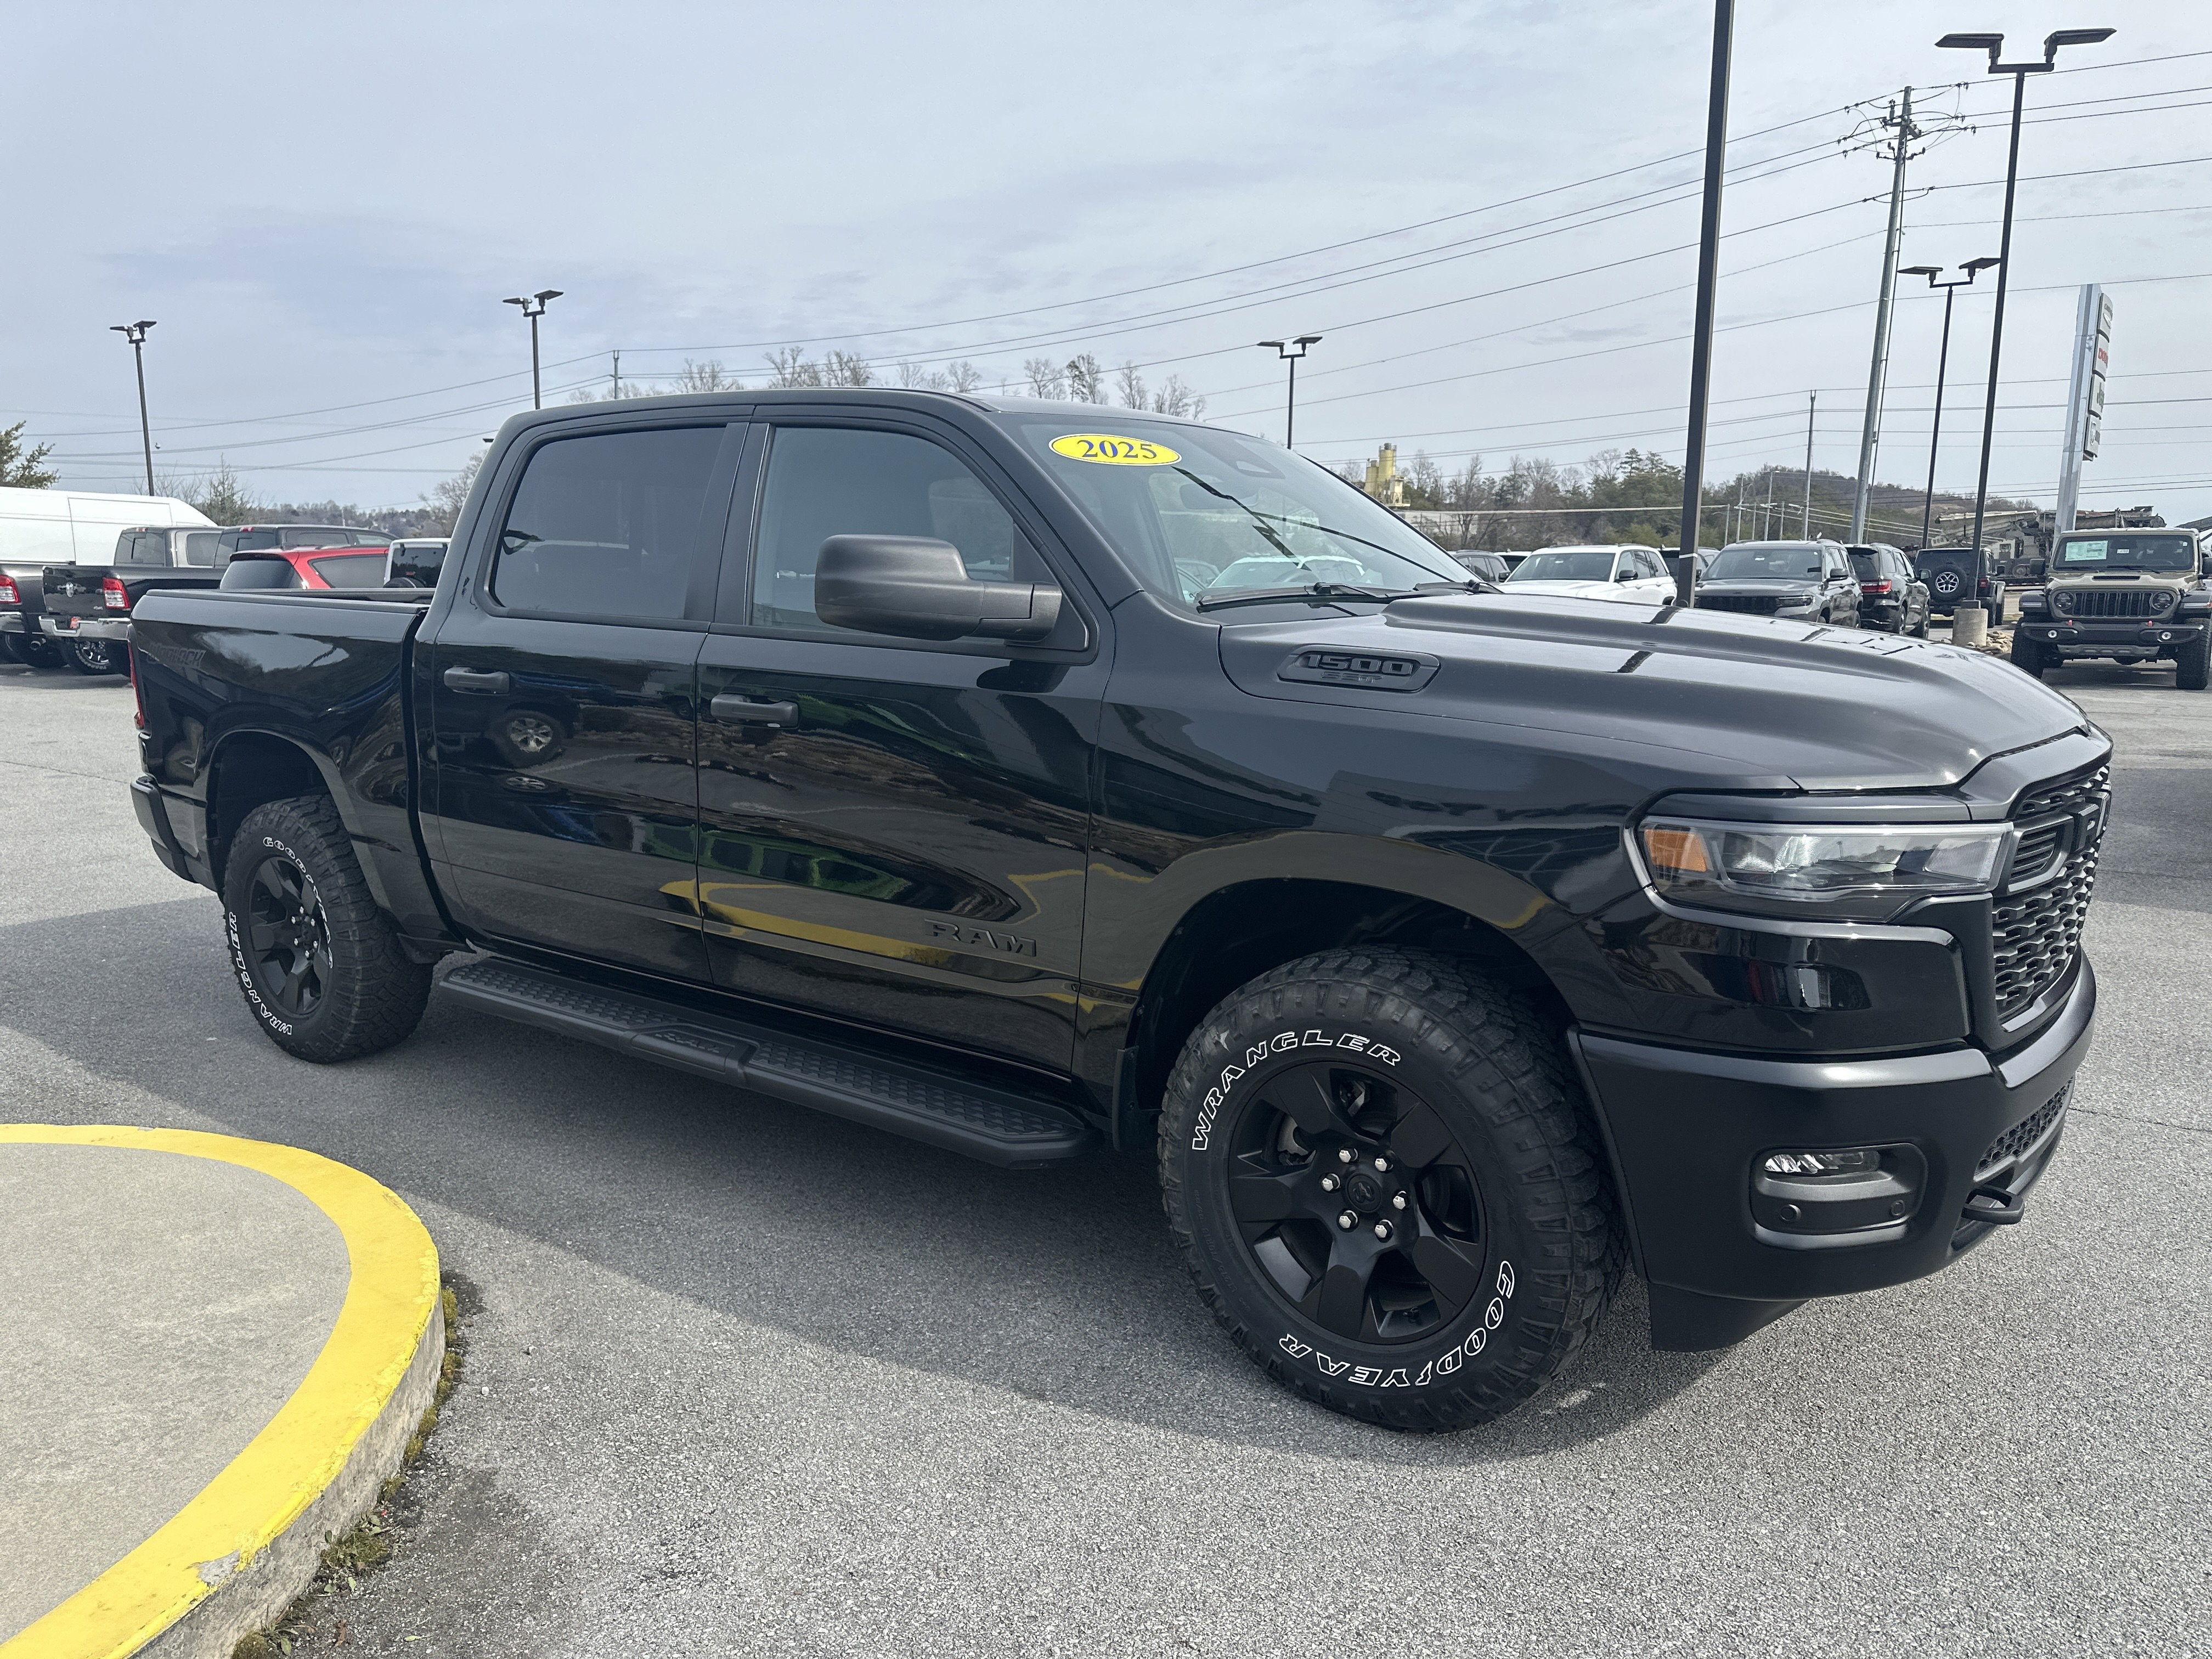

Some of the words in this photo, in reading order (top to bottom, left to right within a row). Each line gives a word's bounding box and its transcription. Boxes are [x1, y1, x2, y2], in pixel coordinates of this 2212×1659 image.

[1077, 439, 1158, 459] 2025
[1307, 653, 1413, 676] 1500
[229, 911, 292, 1036] WRANGLER
[924, 918, 1036, 957] RAM
[1192, 1029, 1401, 1152] WRANGLER
[1279, 1260, 1515, 1387] GOODYEAR
